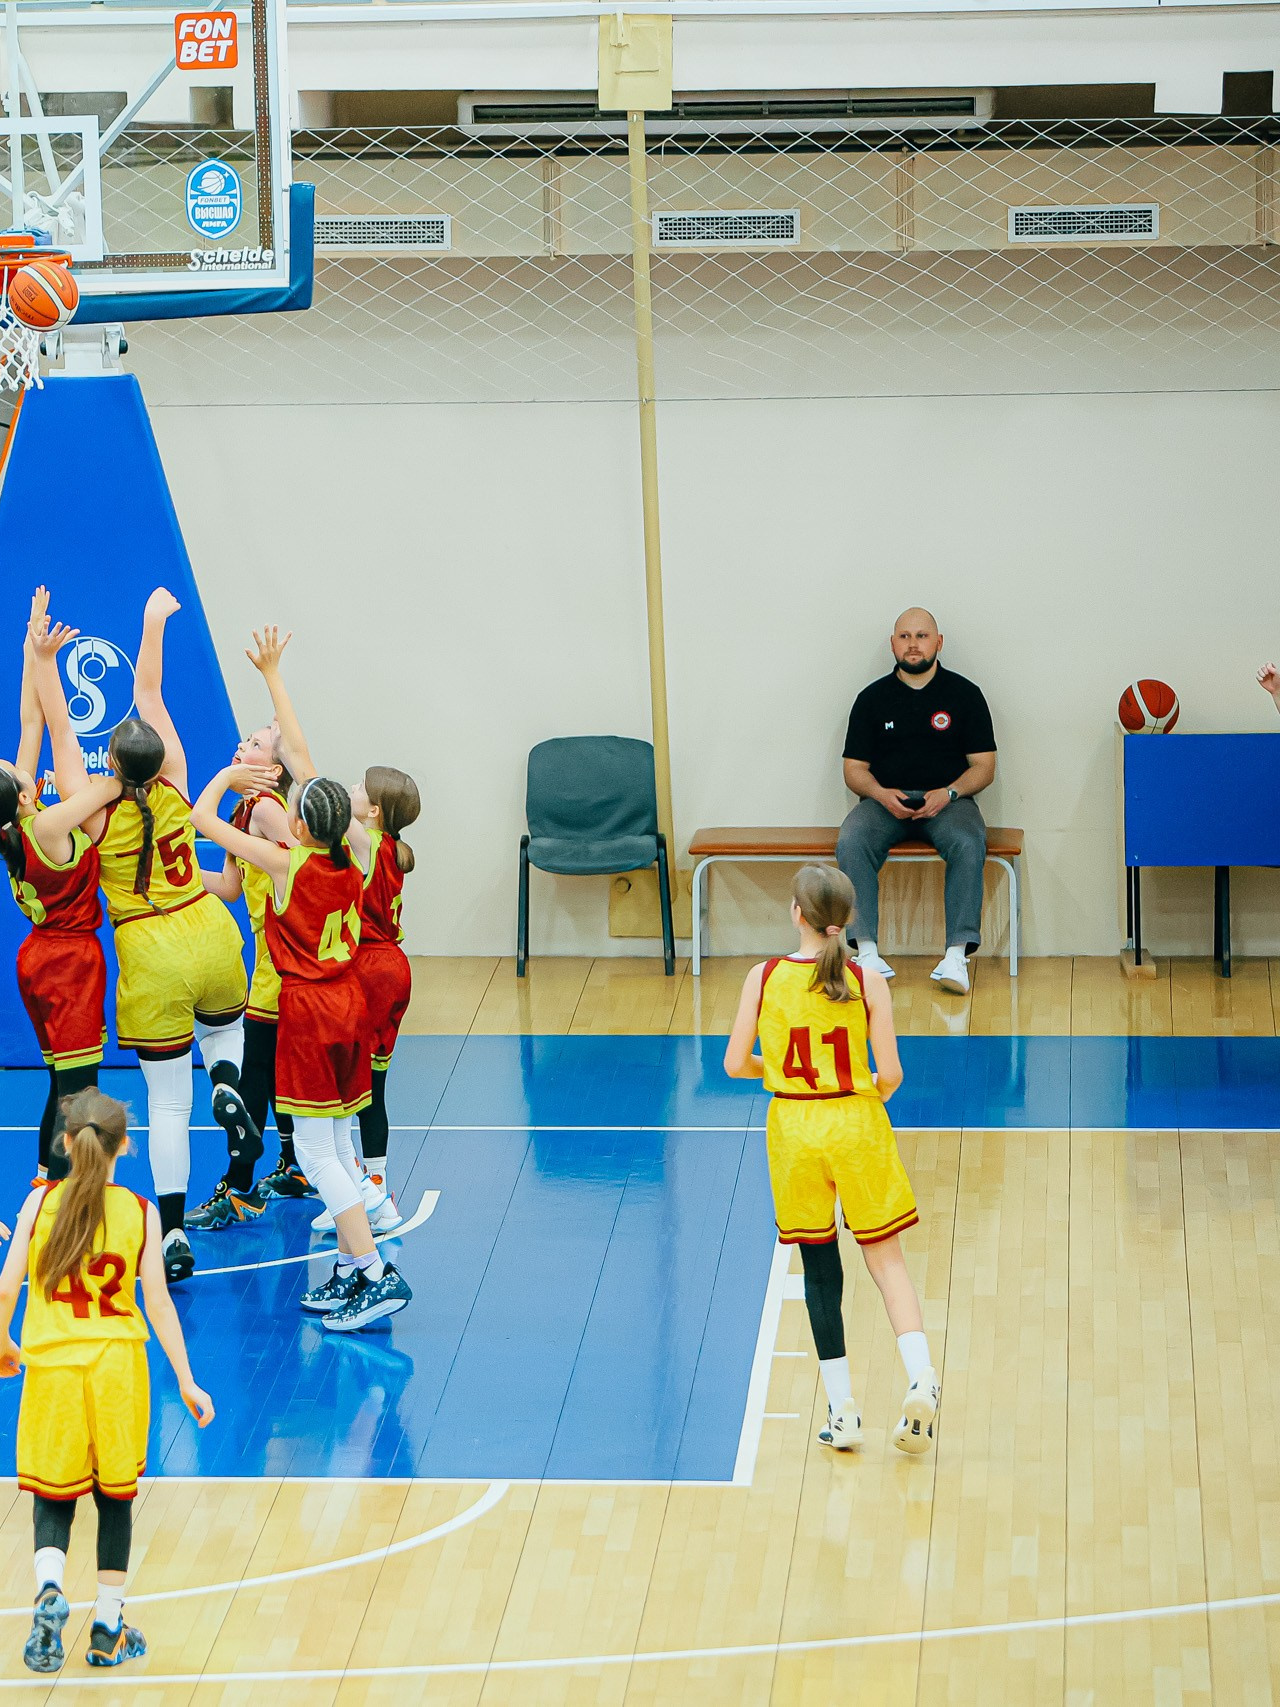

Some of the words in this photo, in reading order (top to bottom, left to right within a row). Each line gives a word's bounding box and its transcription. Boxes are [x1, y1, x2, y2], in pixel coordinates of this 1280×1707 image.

[178, 18, 233, 40] FON
[179, 40, 234, 63] BET
[195, 206, 234, 219] ВЫСШАЯ
[188, 246, 274, 271] Schelde
[201, 261, 272, 271] international
[782, 1026, 854, 1091] 41
[51, 1251, 135, 1318] 42
